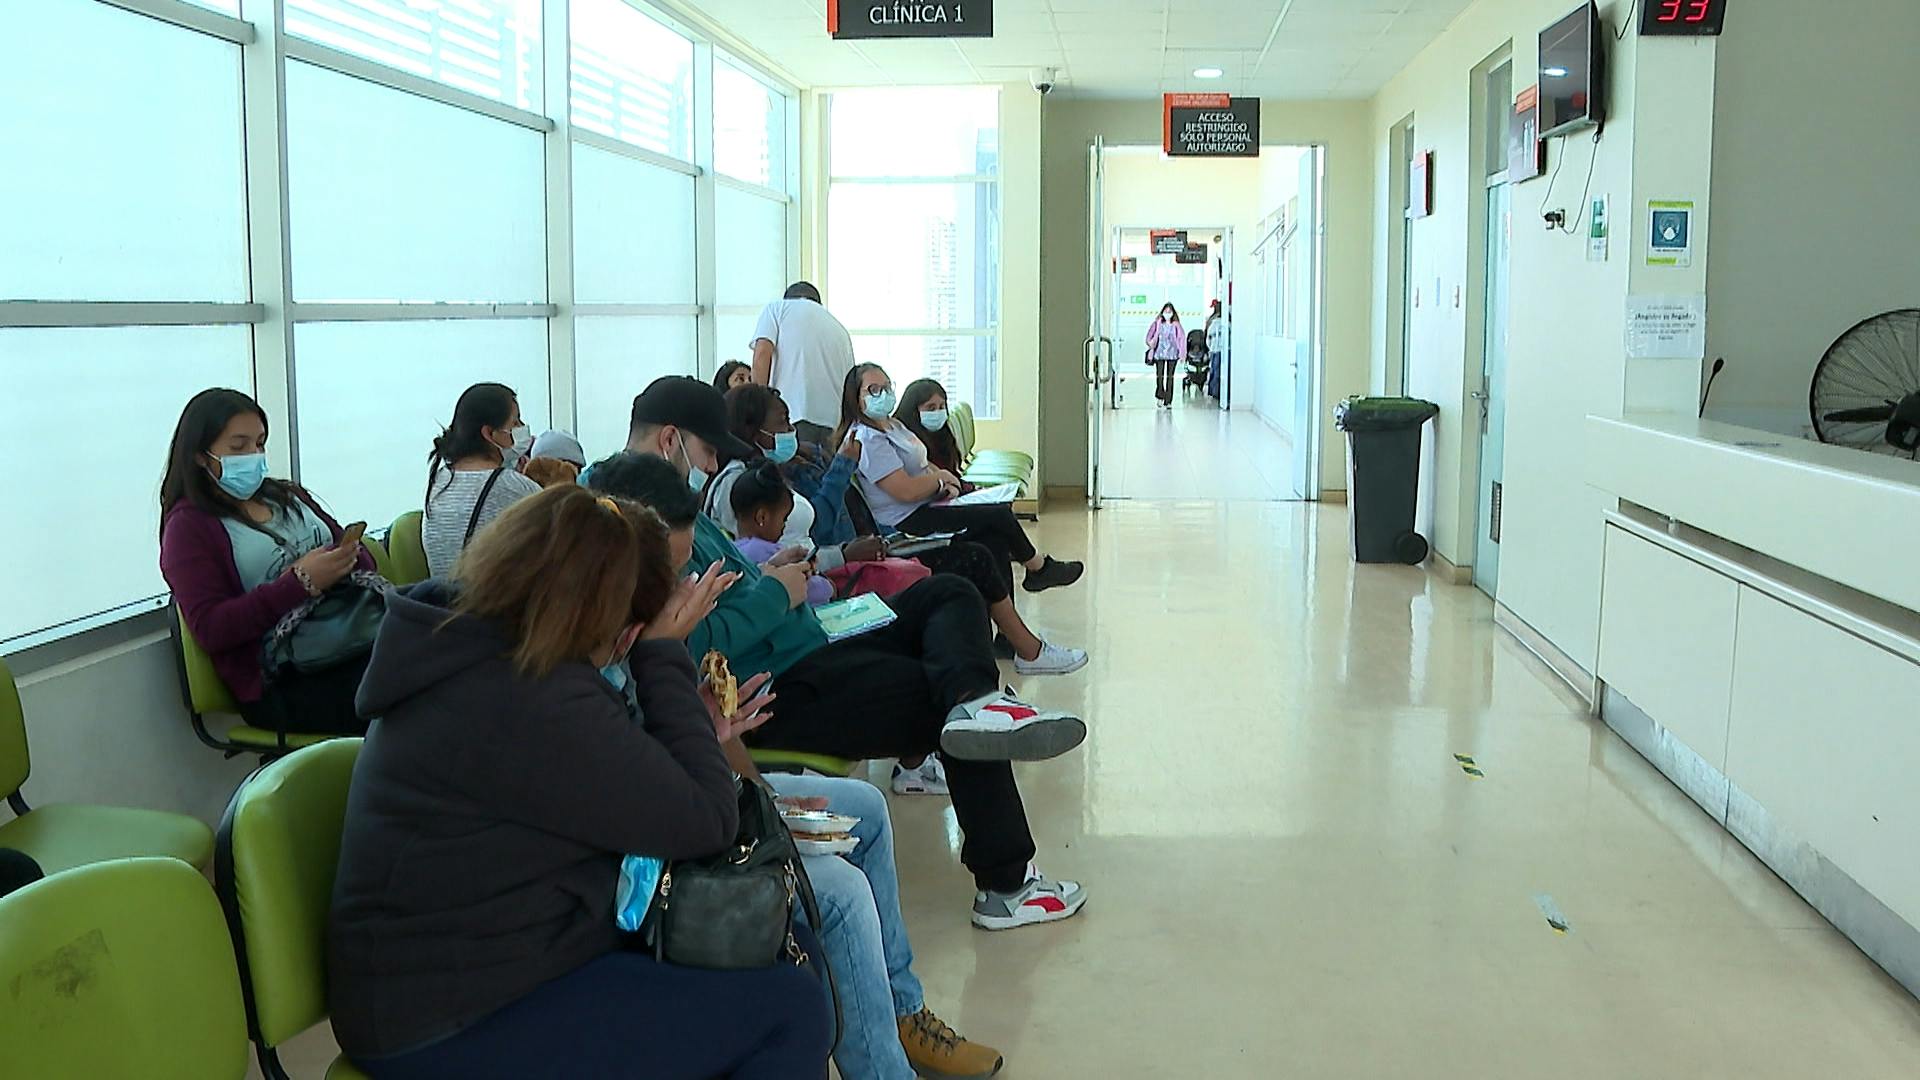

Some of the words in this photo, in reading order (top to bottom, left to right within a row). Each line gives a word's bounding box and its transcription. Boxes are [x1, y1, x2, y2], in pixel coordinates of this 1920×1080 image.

[869, 0, 947, 24] CLÍNICA
[954, 5, 964, 22] 1
[1657, 0, 1709, 20] 33
[1198, 113, 1234, 122] ACCESO
[1185, 123, 1248, 132] RESTRINGIDO
[1206, 132, 1252, 142] PERSONAL
[1186, 143, 1246, 152] AUTORIZADO
